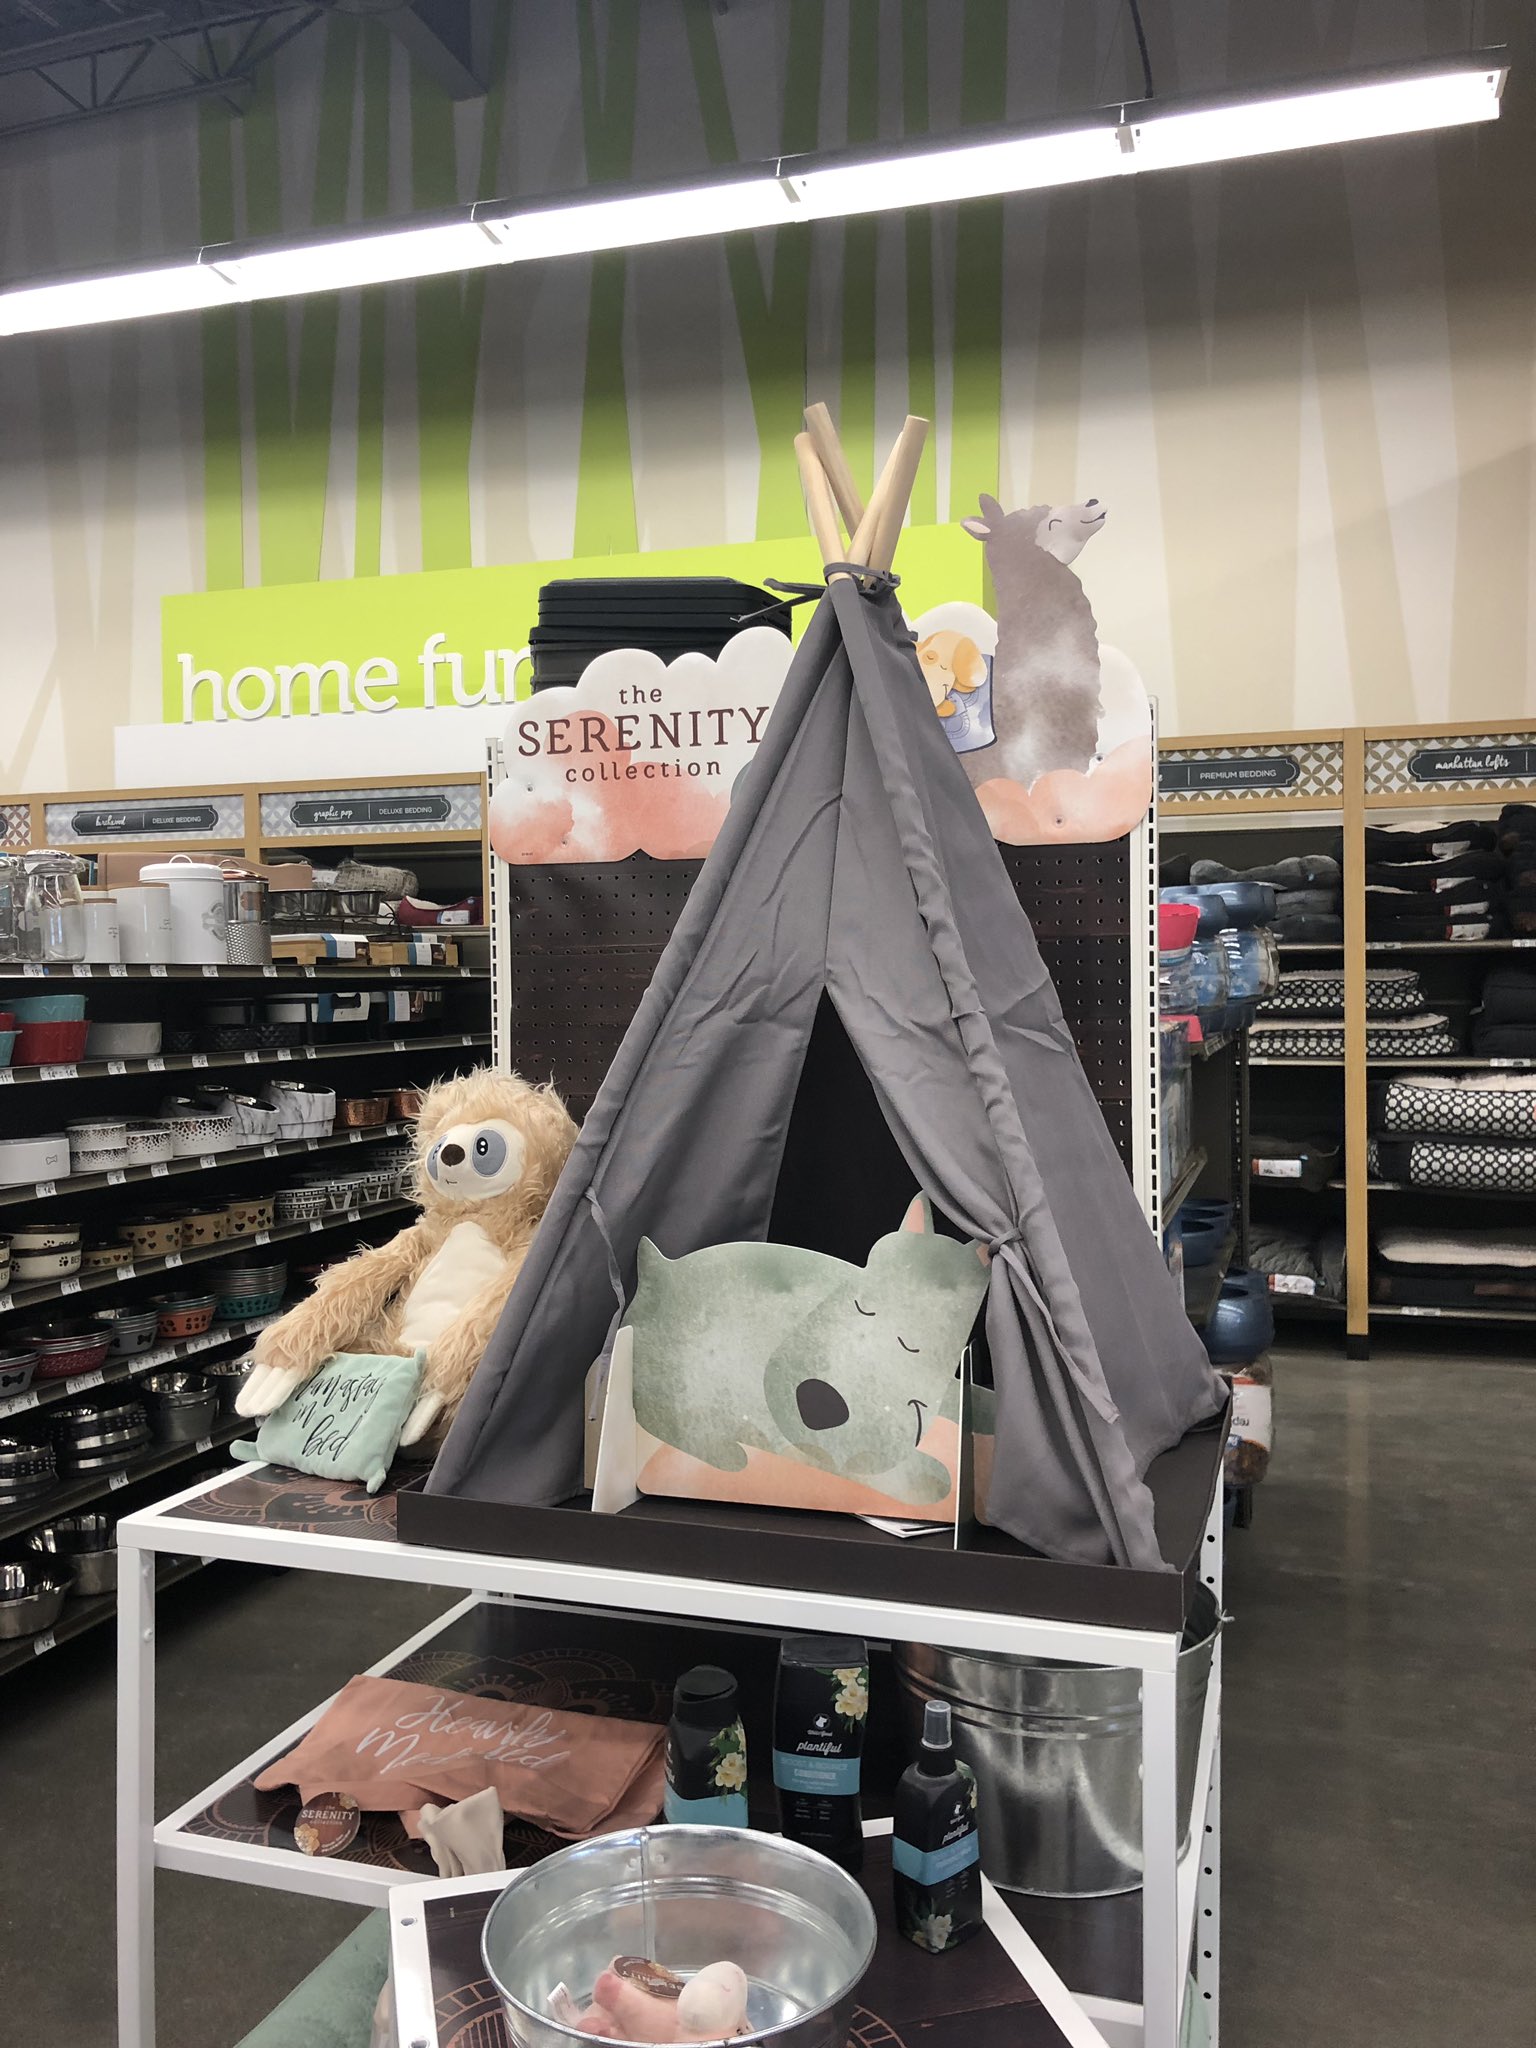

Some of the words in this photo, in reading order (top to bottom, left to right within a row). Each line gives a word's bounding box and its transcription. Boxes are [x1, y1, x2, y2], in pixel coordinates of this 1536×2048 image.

[177, 653, 399, 724] home
[619, 685, 662, 704] the
[518, 706, 770, 757] SERENITY
[565, 759, 722, 782] collection
[1435, 754, 1483, 770] manhattan
[1485, 753, 1510, 770] lofts
[1200, 770, 1238, 780] PREMIUM
[1239, 769, 1277, 779] BEDDING
[378, 807, 403, 815] DELUXE
[404, 805, 433, 814] BEDDING
[152, 816, 175, 825] DELUXE
[175, 815, 202, 823] BEDDING
[292, 1401, 318, 1429] in
[302, 1413, 364, 1462] bed
[395, 1694, 567, 1748] Heavily
[796, 1740, 842, 1756] plantiful
[301, 1809, 355, 1821] SERENITY
